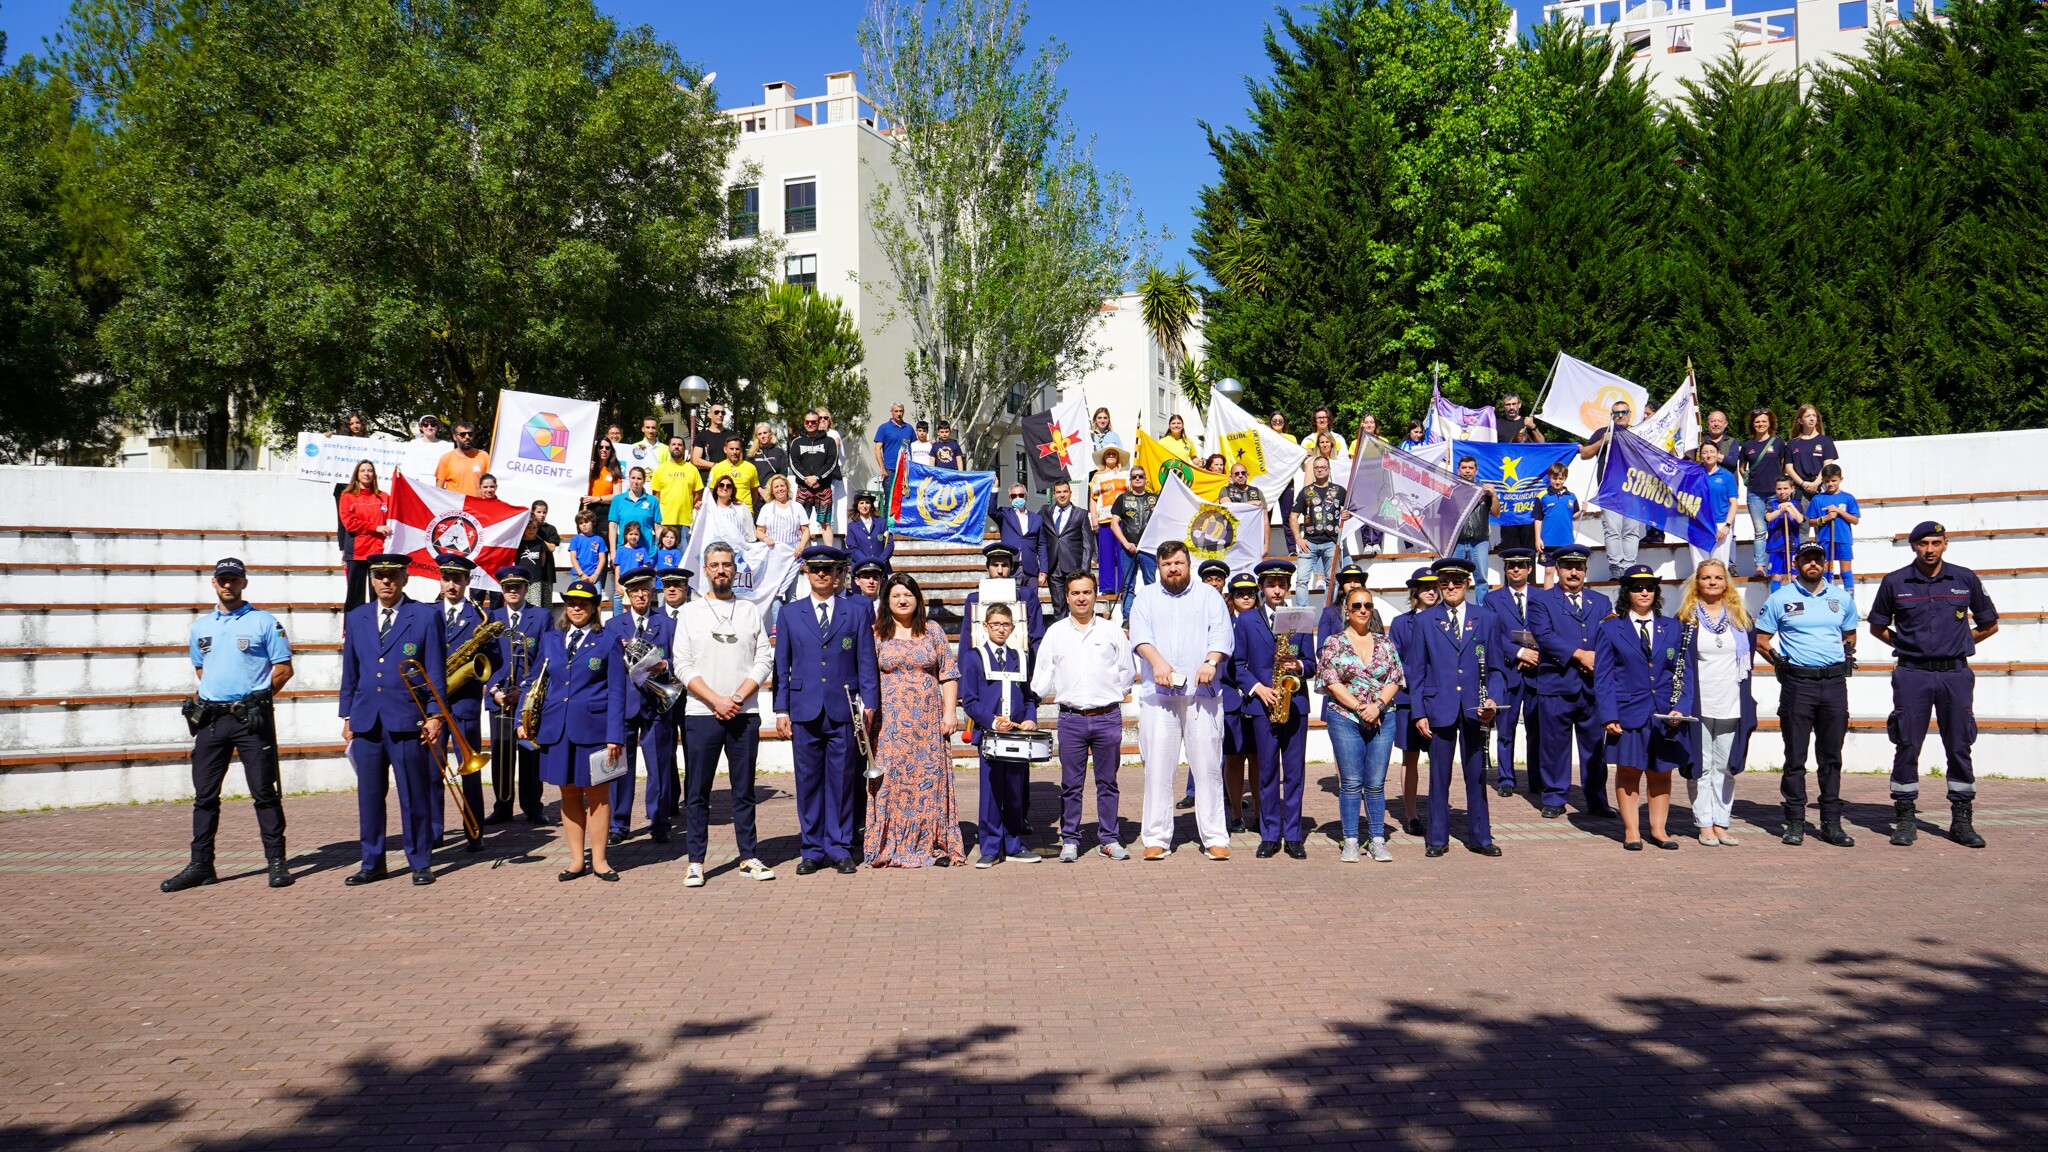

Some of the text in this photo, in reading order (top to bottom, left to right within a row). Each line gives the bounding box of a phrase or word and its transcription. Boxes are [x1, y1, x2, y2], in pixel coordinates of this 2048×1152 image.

[506, 460, 573, 478] CRIAGENTE
[1621, 467, 1703, 519] SOMOS UM
[425, 520, 437, 542] CENTRO
